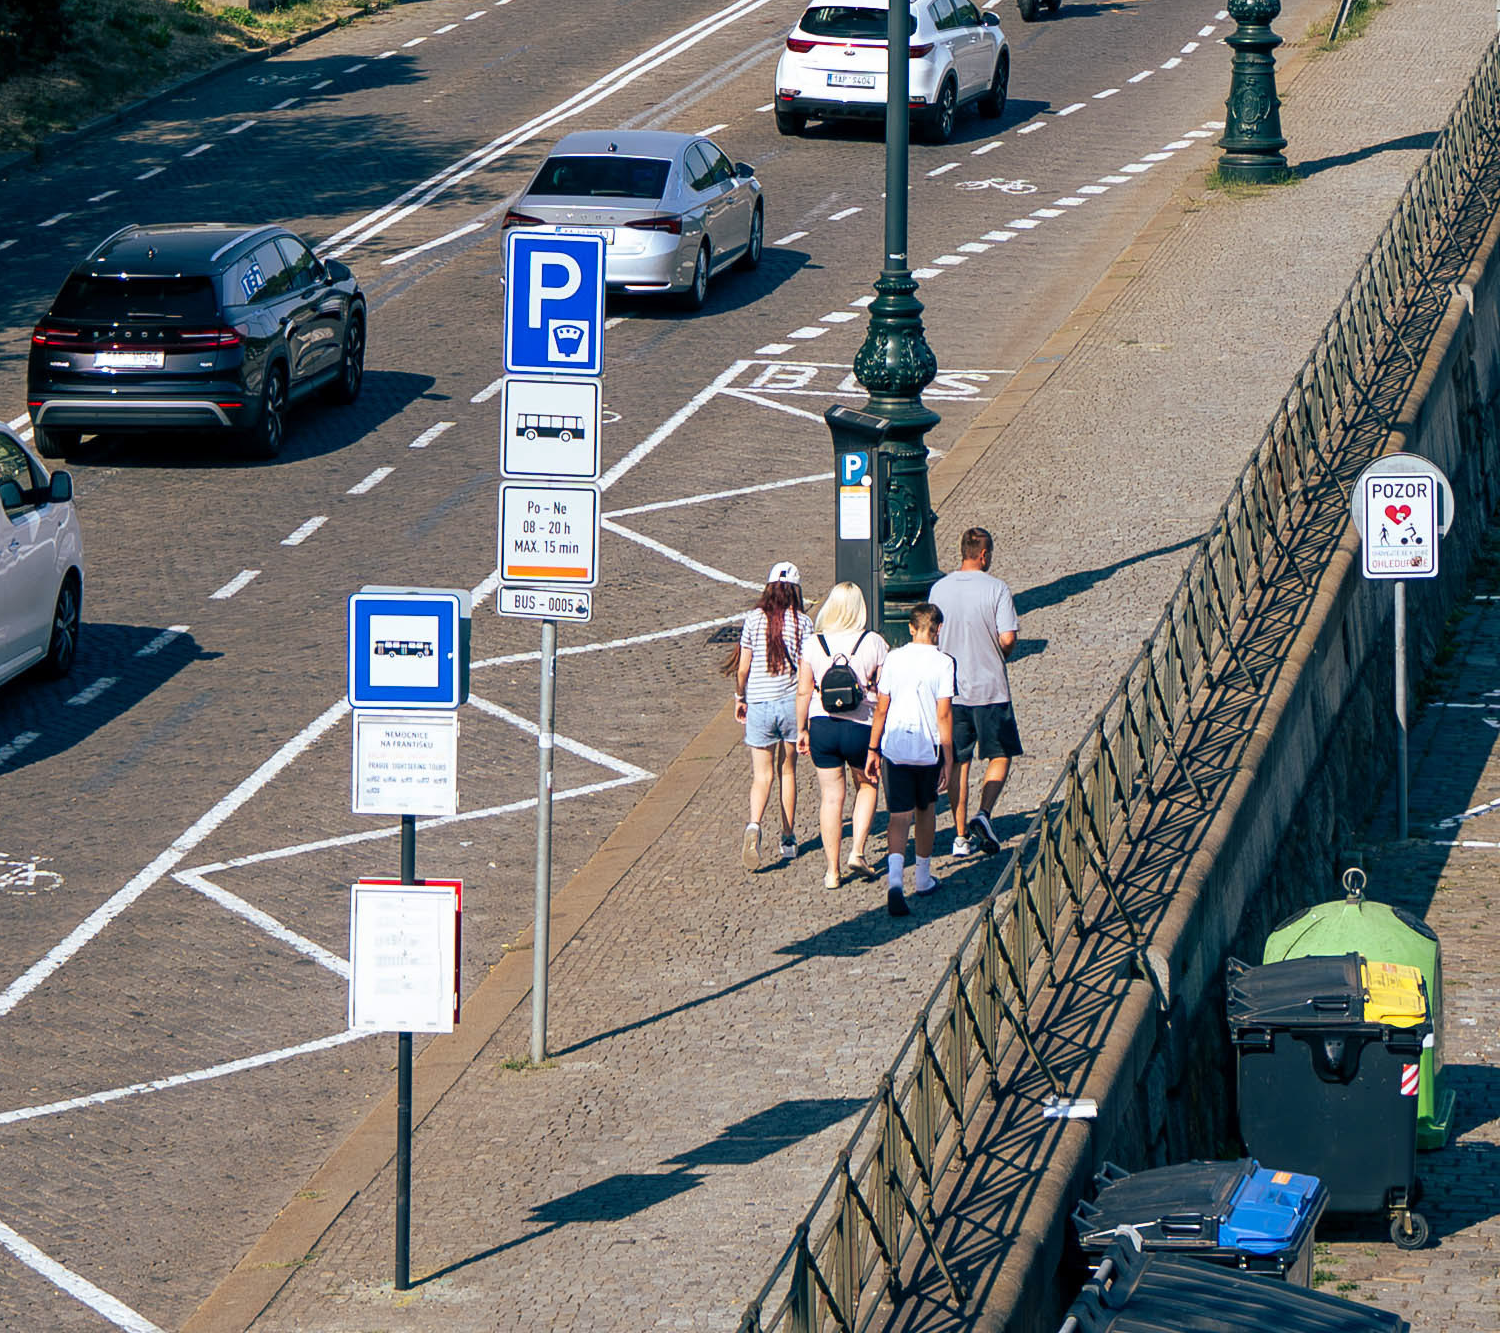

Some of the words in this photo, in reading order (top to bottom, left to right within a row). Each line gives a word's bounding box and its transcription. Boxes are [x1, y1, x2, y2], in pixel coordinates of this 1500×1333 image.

[528, 251, 582, 329] P
[845, 454, 862, 480] P
[1372, 483, 1428, 500] POZOR
[527, 500, 541, 514] Po
[553, 501, 567, 515] Ne
[523, 520, 536, 534] 08
[548, 521, 561, 534] 20
[564, 521, 571, 535] h
[514, 540, 540, 554] MAX.
[544, 540, 556, 553] 15
[559, 541, 579, 554] min
[514, 594, 536, 610] BUS
[548, 597, 574, 613] 0005
[384, 730, 429, 740] NEMOCNICE
